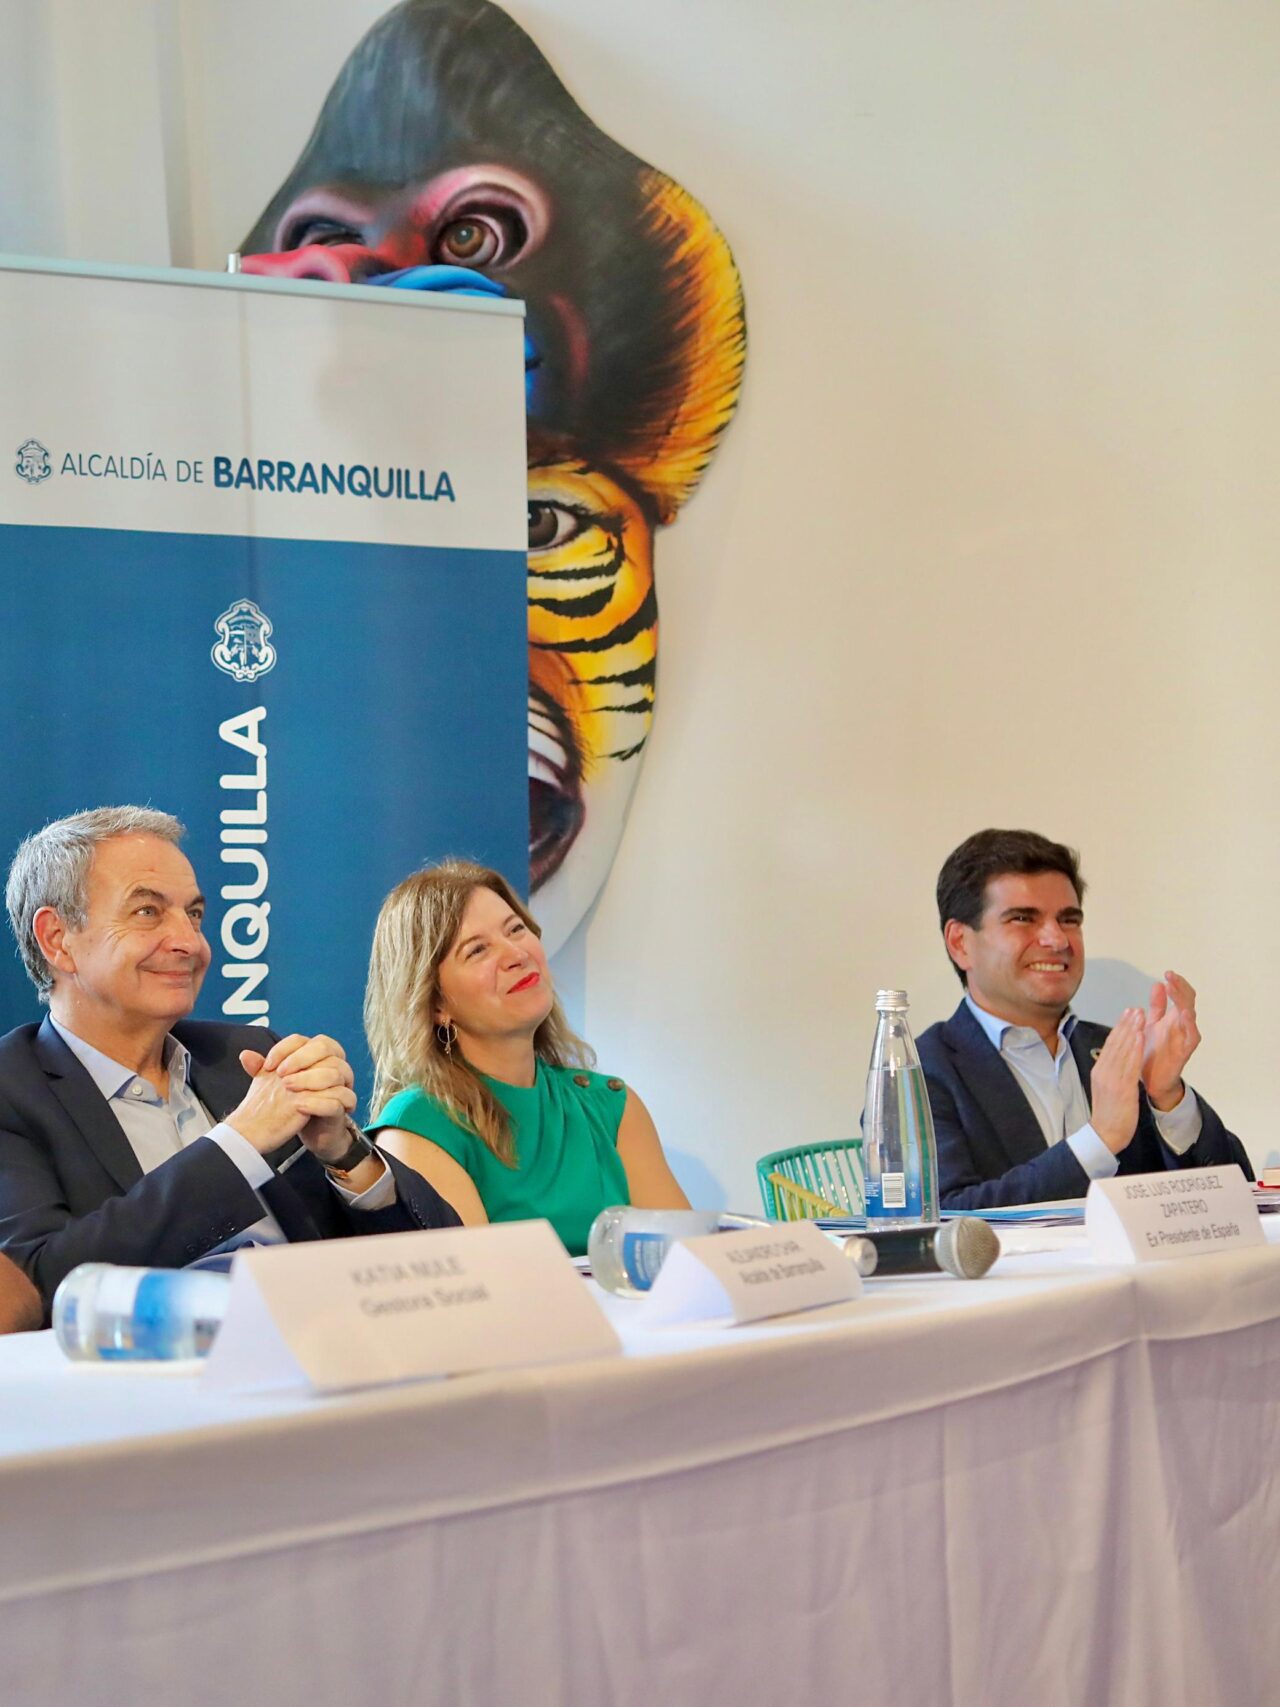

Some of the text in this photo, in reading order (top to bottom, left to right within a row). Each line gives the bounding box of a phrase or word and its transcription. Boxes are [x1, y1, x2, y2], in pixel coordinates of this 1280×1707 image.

[60, 453, 456, 502] ALCALDÍA DE BARRANQUILLA
[1149, 1178, 1172, 1197] LUIS
[1160, 1199, 1208, 1217] ZAPATERO
[1146, 1221, 1241, 1248] Ex Presidente de España
